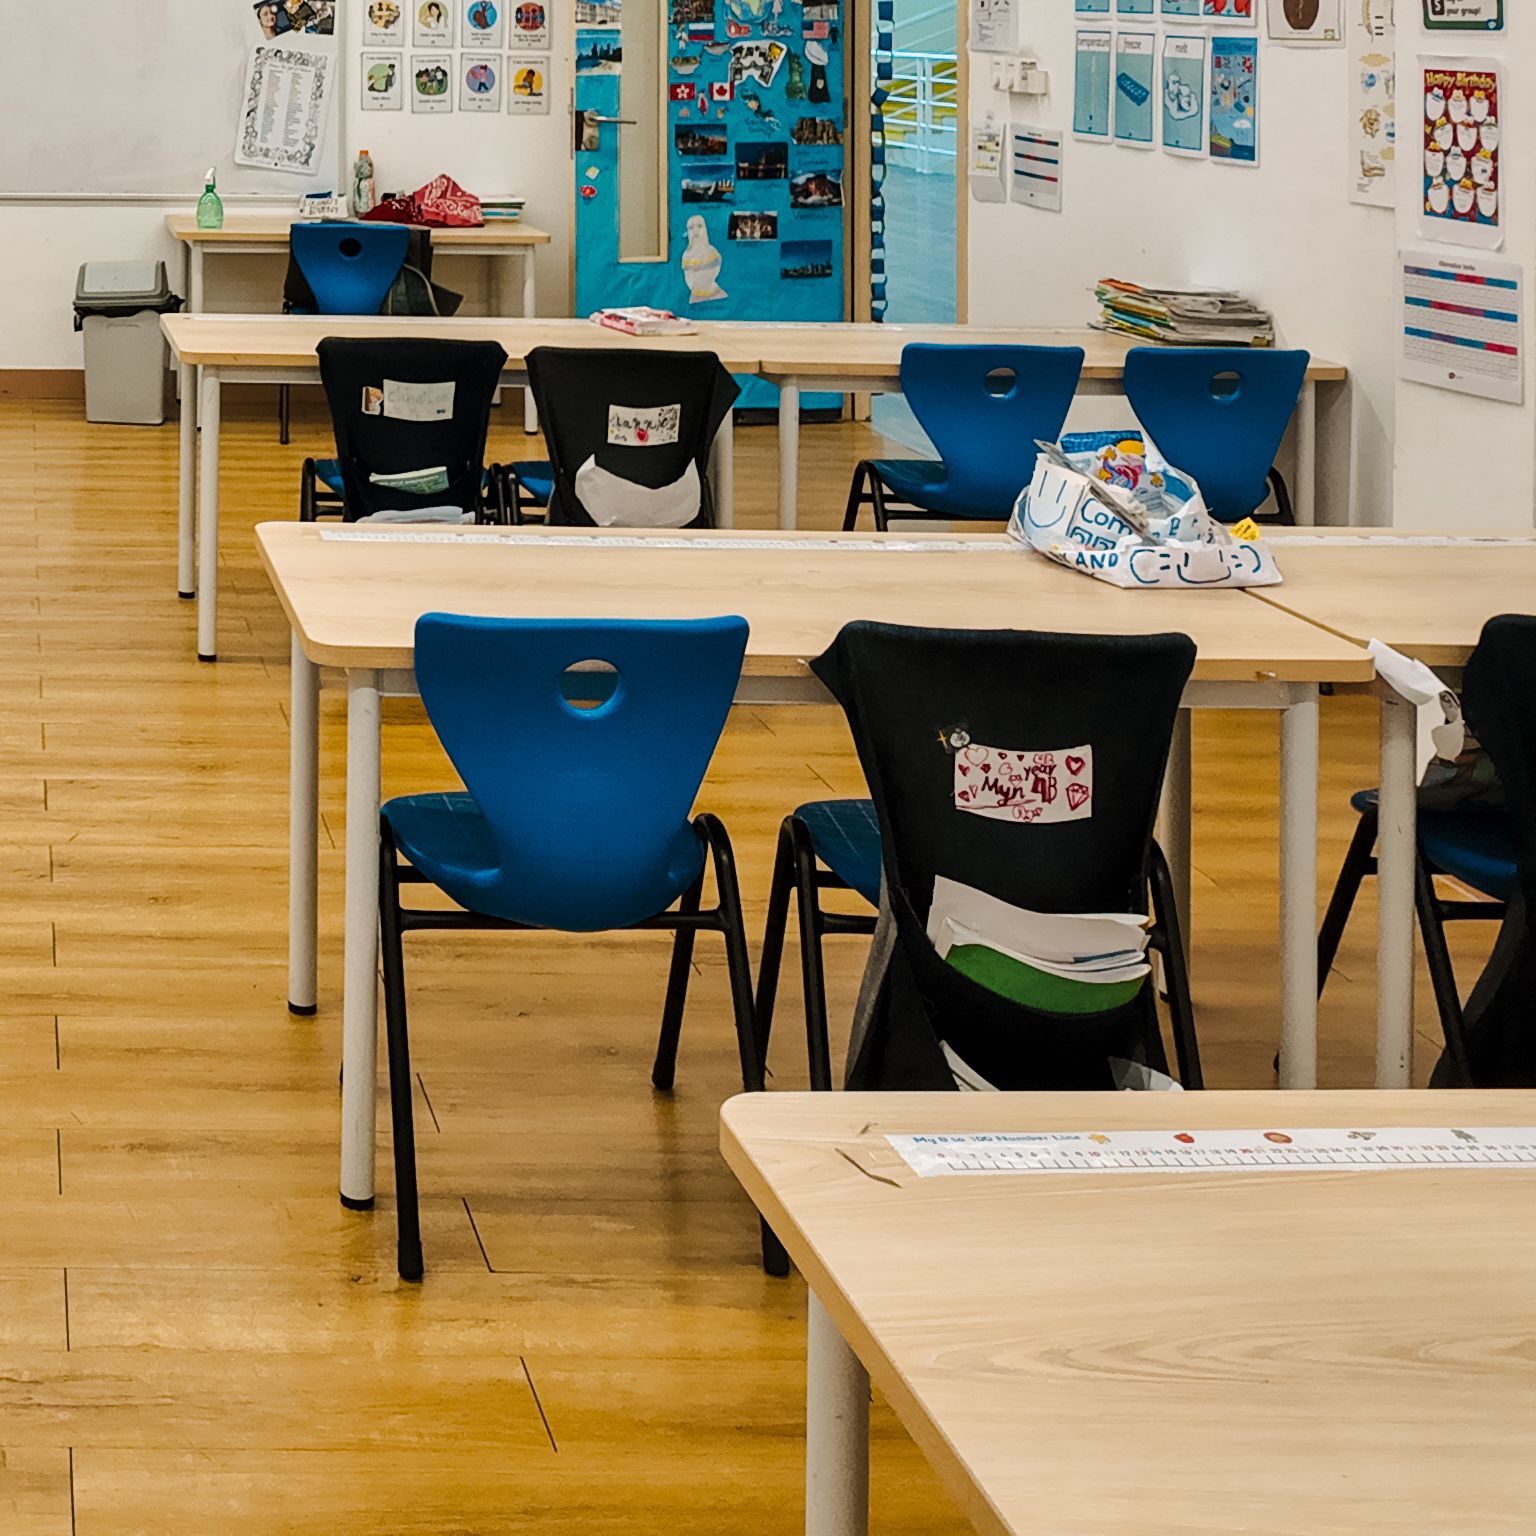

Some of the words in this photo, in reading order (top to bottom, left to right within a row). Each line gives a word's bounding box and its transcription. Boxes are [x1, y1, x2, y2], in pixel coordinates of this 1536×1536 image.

[1426, 72, 1456, 89] Happy
[1456, 72, 1496, 93] Birthday
[1075, 552, 1119, 569] AND
[1024, 764, 1057, 781] year
